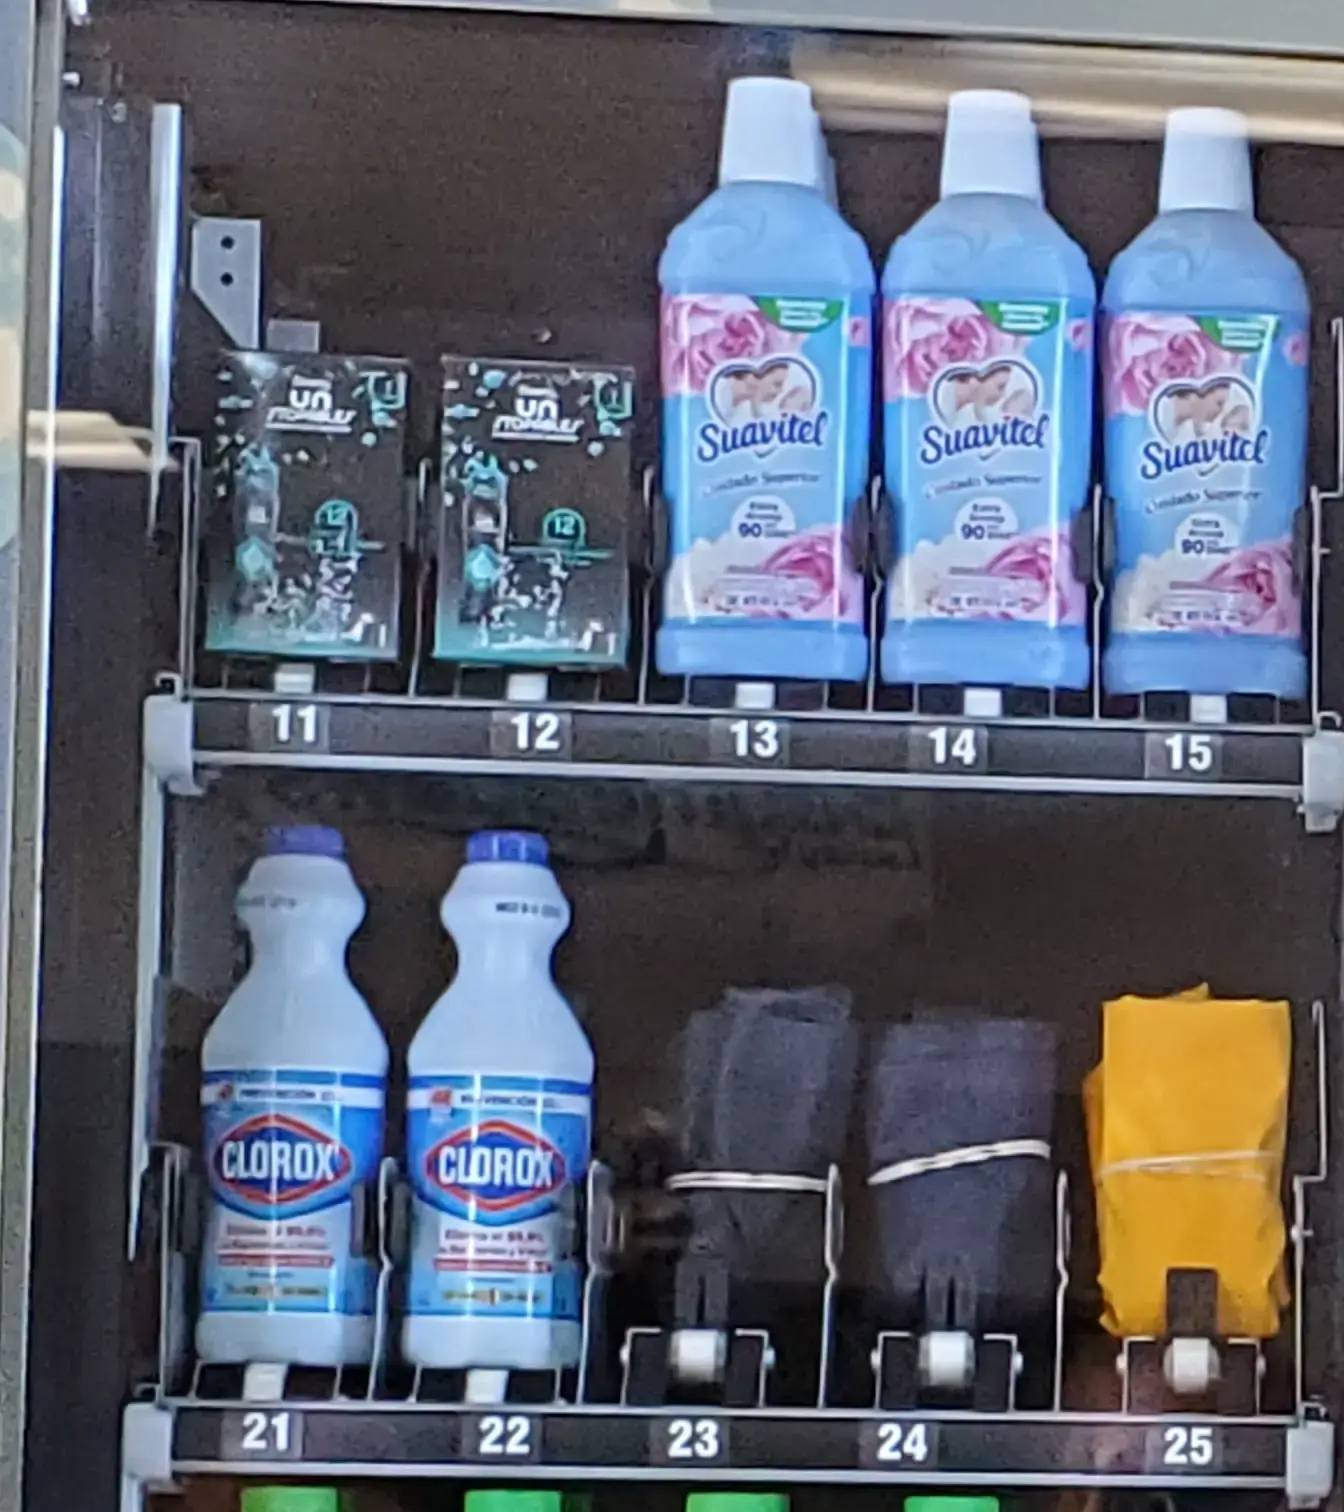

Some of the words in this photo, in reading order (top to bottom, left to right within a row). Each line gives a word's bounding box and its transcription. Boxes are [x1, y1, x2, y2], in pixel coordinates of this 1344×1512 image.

[696, 411, 829, 464] Suavitel
[920, 413, 1050, 465] Suavitel
[1140, 429, 1269, 480] Suavitel
[272, 705, 317, 742] 11
[511, 713, 560, 751] 12
[730, 720, 779, 758] 13
[929, 727, 977, 766] 14
[1164, 734, 1212, 772] 15
[222, 1140, 336, 1181] CLOROX
[438, 1146, 554, 1188] CLOROX
[242, 1411, 291, 1451] 21
[478, 1416, 531, 1455] 22
[667, 1418, 719, 1458] 23
[876, 1423, 929, 1463] 24
[1163, 1426, 1214, 1465] 25
